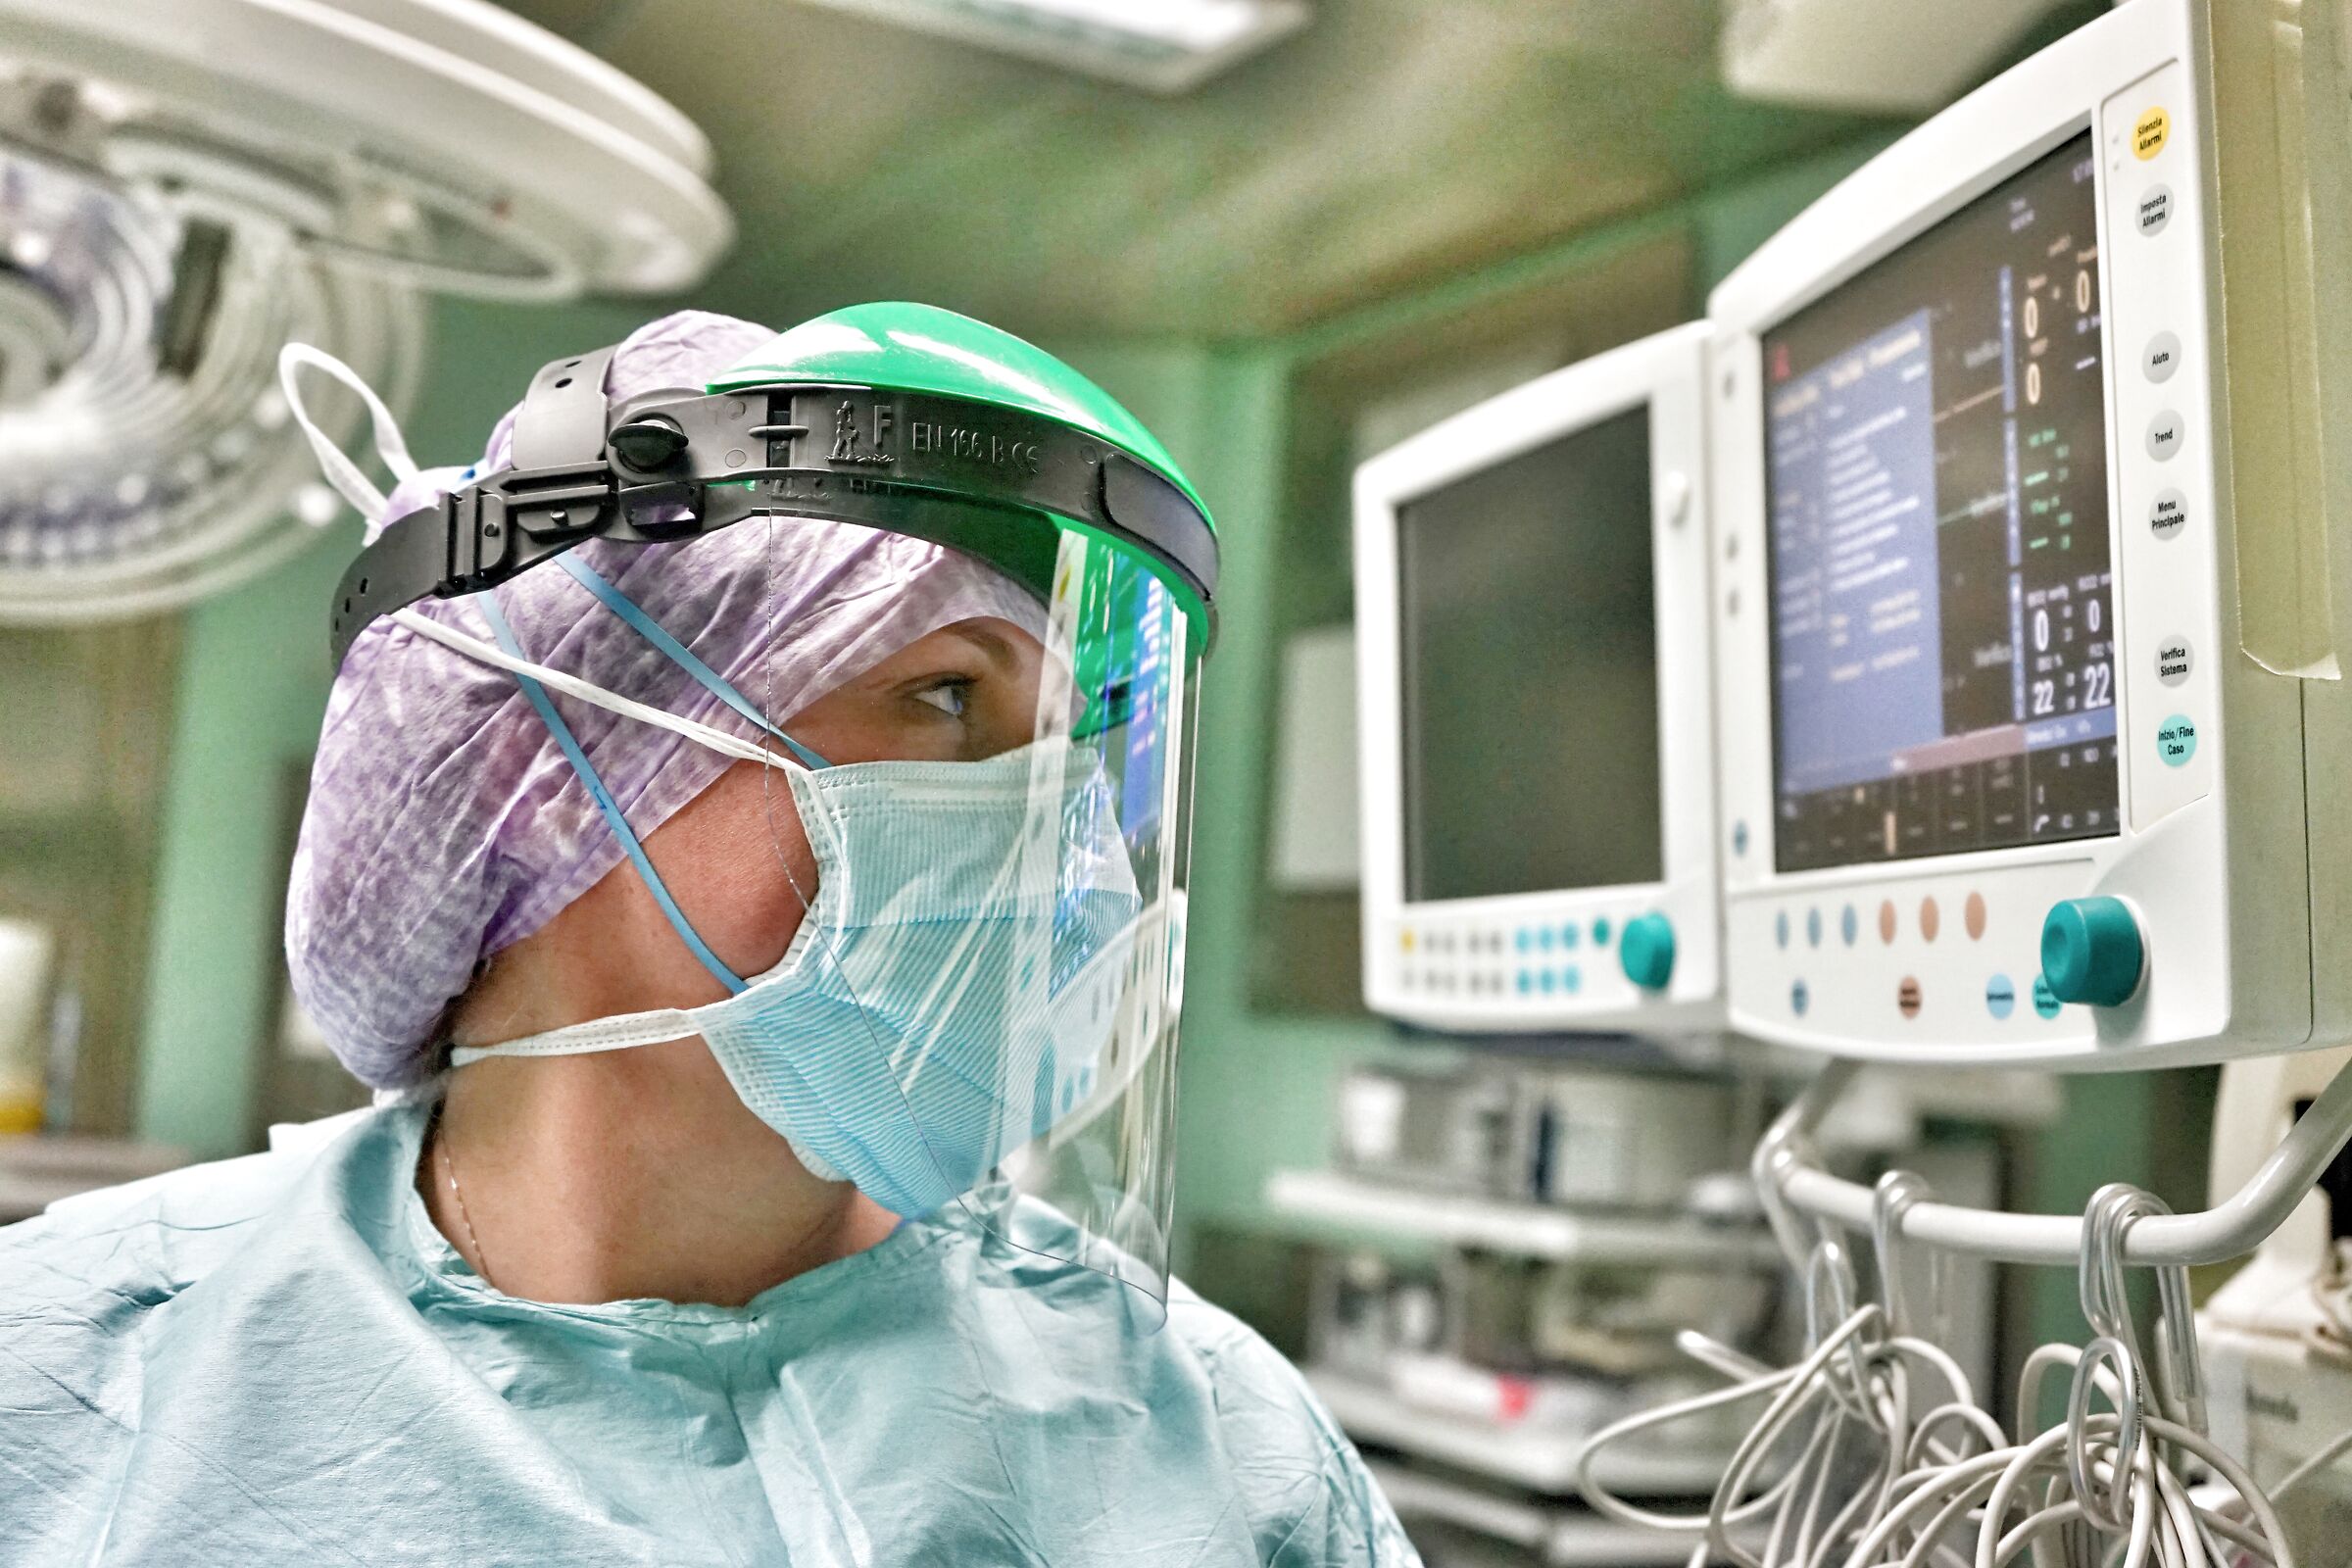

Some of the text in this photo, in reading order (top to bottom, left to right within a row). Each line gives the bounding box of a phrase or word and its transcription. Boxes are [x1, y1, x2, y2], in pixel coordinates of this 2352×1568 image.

[2139, 130, 2162, 151] Allarmi
[2140, 194, 2167, 214] Imposta
[2142, 210, 2166, 228] Allarmi
[2152, 352, 2170, 367] Aiuto
[912, 422, 942, 452] EN
[2155, 428, 2173, 444] Trend
[2158, 500, 2177, 513] Menu
[2152, 513, 2184, 530] Principale
[2161, 647, 2185, 662] Verifica
[2161, 662, 2187, 677] Sistema
[2033, 679, 2054, 715] 22
[2084, 662, 2111, 709] 22
[2168, 744, 2184, 756] Caso
